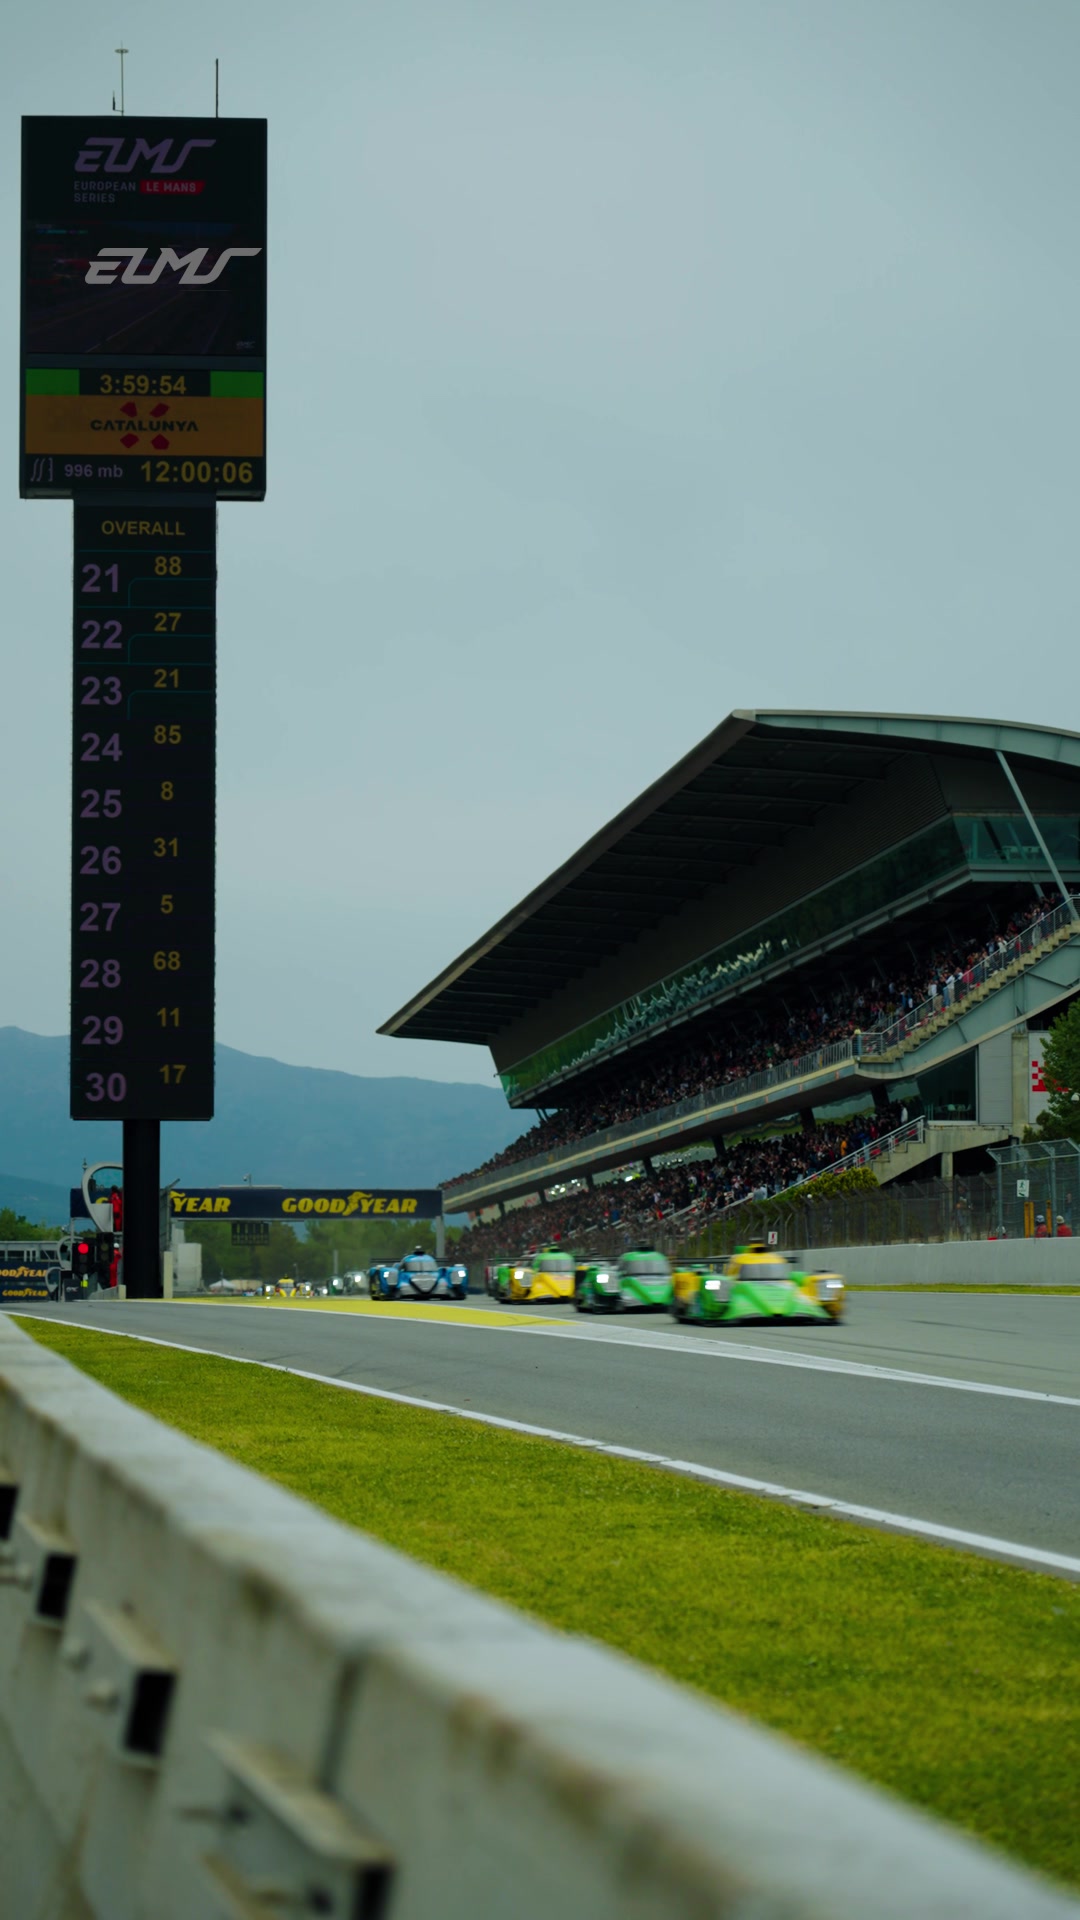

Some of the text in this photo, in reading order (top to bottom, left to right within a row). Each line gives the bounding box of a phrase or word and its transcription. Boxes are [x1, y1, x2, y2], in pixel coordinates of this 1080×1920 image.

[74, 181, 196, 193] EUROPEAN LE MANS
[74, 193, 116, 203] SERIES
[100, 375, 187, 394] 3:59:54
[90, 420, 199, 432] CATALUNYA
[64, 464, 123, 478] 996 mb
[141, 461, 253, 483] 12:00:06
[101, 521, 186, 535] OVERALL
[82, 556, 182, 593] 21 88
[82, 613, 182, 649] 22 27
[81, 669, 179, 706] 23 21
[80, 725, 182, 762] 24 85
[80, 781, 174, 818] 25 8
[80, 838, 178, 875] 26 31
[79, 894, 174, 932] 27 5
[79, 951, 181, 988] 28 68
[81, 1007, 180, 1045] 29 11
[85, 1064, 187, 1102] 30 17
[282, 1192, 418, 1216] GOODYEAR
